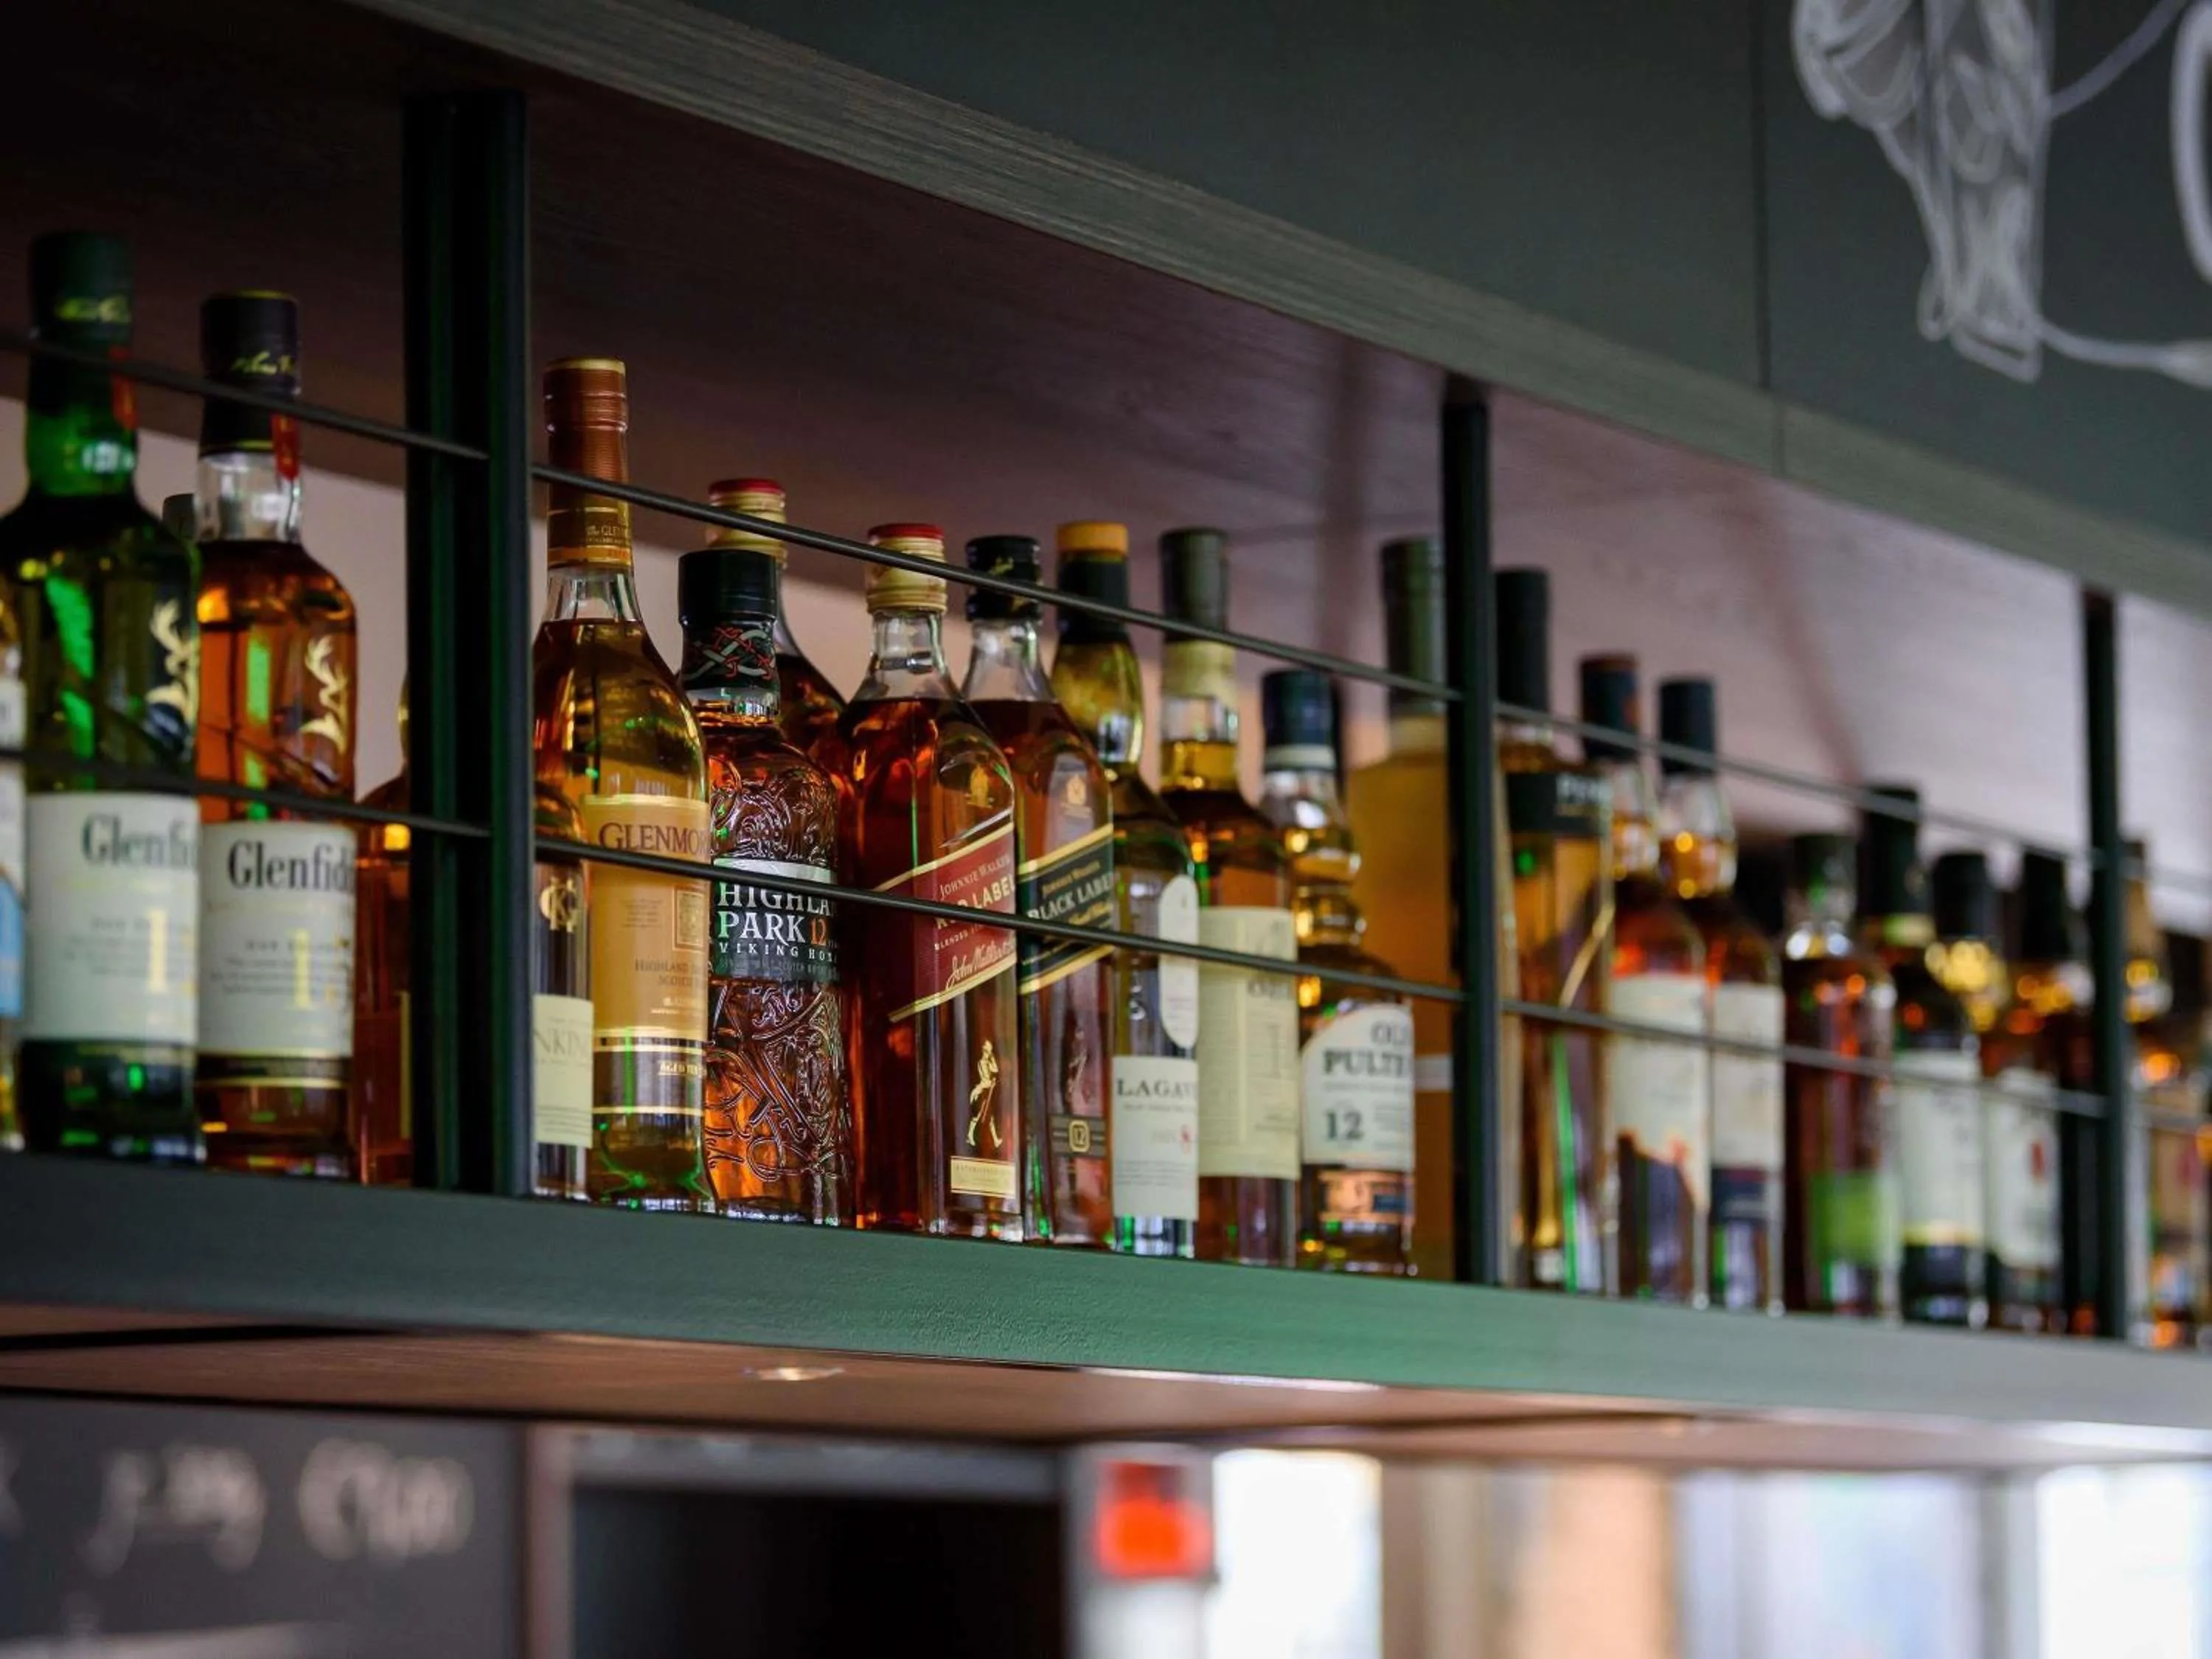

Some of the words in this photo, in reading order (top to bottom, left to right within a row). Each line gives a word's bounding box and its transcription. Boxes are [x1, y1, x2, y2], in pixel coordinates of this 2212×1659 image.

[717, 911, 806, 947] PARK
[719, 941, 799, 959] VIKING
[1324, 1108, 1364, 1141] 12
